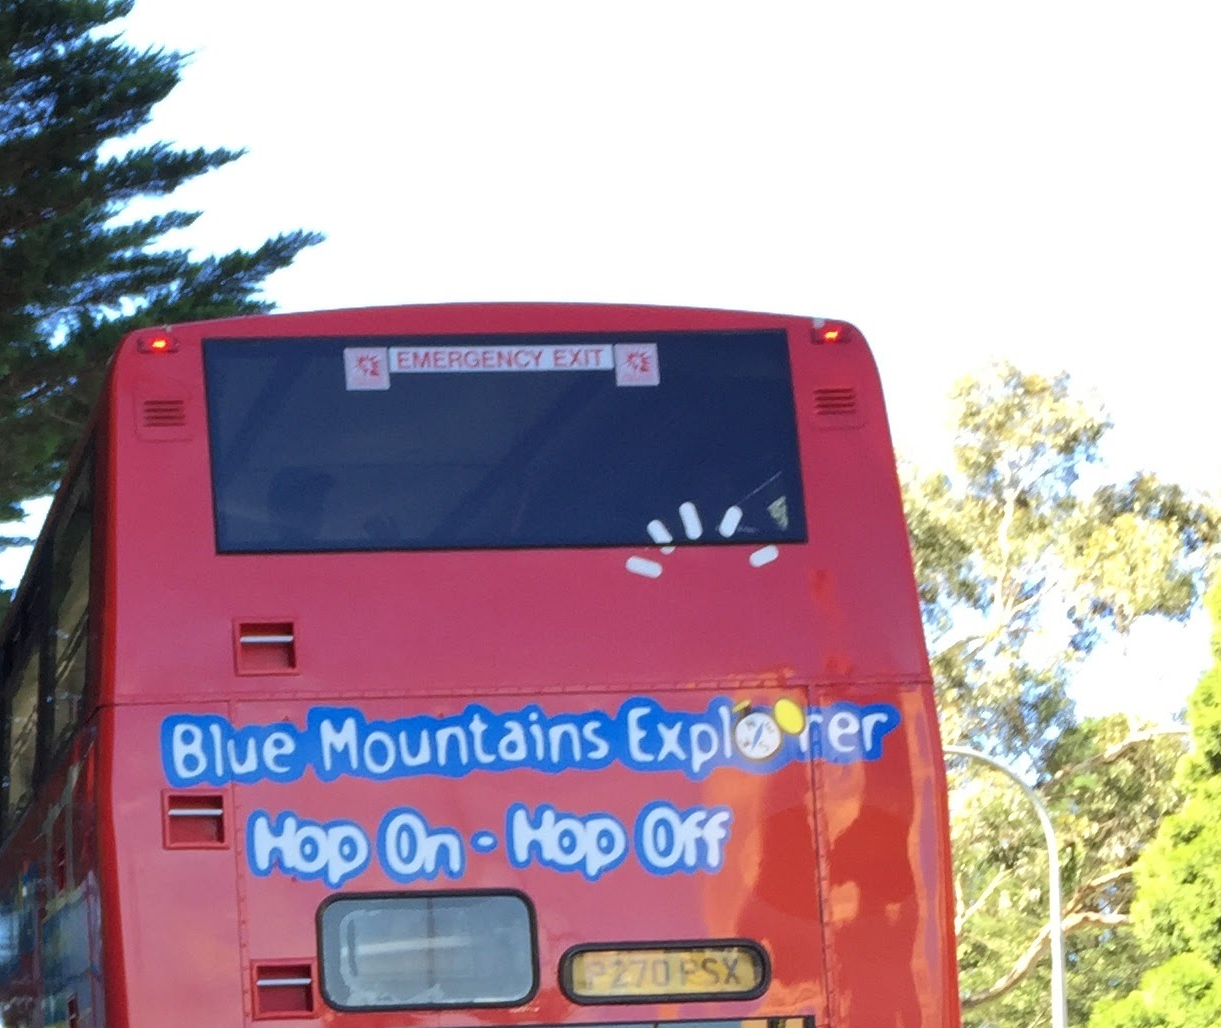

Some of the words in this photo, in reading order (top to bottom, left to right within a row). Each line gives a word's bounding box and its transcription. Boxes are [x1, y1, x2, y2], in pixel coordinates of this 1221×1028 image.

[396, 349, 544, 370] EMERGENCY
[553, 348, 603, 368] EXIT
[172, 723, 295, 778] Blue
[319, 713, 609, 771] Mountains
[253, 815, 370, 884] Hop
[385, 813, 462, 873] On
[513, 809, 626, 877] Hop
[642, 806, 729, 868] Off
